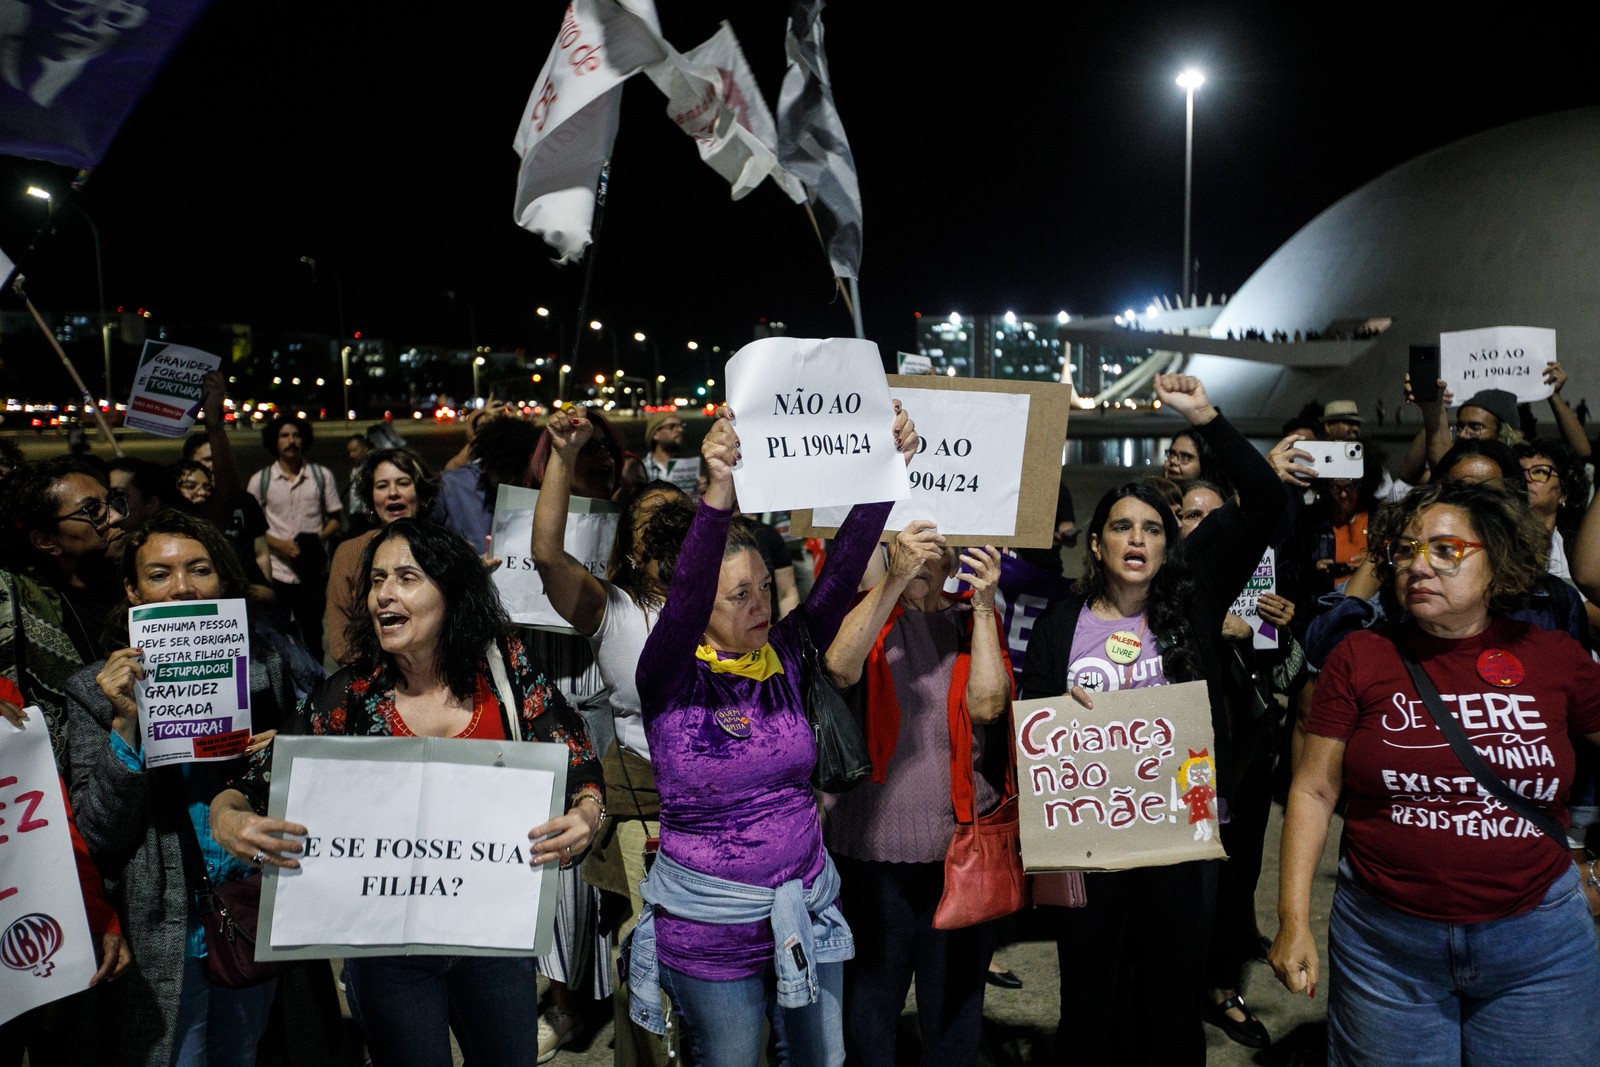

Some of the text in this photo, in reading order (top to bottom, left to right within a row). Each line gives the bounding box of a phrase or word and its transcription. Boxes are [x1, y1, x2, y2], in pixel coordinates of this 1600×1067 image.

[154, 355, 213, 371] GRAVIDEZ
[1469, 348, 1525, 363] NÃO AO
[1463, 366, 1531, 380] PL 1904/24
[772, 387, 862, 416] NÃO AO
[765, 432, 871, 459] PL 1904/24
[934, 438, 972, 457] AO
[909, 471, 979, 492] 904/24
[506, 556, 517, 570] E
[1253, 567, 1272, 576] LPE
[1252, 578, 1272, 587] VIDA
[1245, 608, 1260, 617] QU
[141, 619, 238, 634] NENHUMA PESSOA
[137, 633, 245, 649] DEVE SER OBRIGADA
[149, 651, 192, 663] GESTAR
[195, 649, 225, 660] FILHO
[228, 648, 241, 658] DE
[1112, 645, 1134, 658] LIVRE
[158, 663, 229, 678] ESTUPRADOR!
[145, 683, 218, 699] GRAVIDEZ
[149, 702, 213, 719] FORÇADA
[1382, 692, 1427, 732] SE
[147, 722, 154, 738] É
[156, 720, 223, 737] TORTURA!
[1019, 708, 1175, 760] Criança
[1031, 756, 1110, 795] não
[303, 836, 525, 865] E SE FOSSE SUA
[360, 875, 464, 897] FILHA?
[3, 917, 56, 968] UBM
